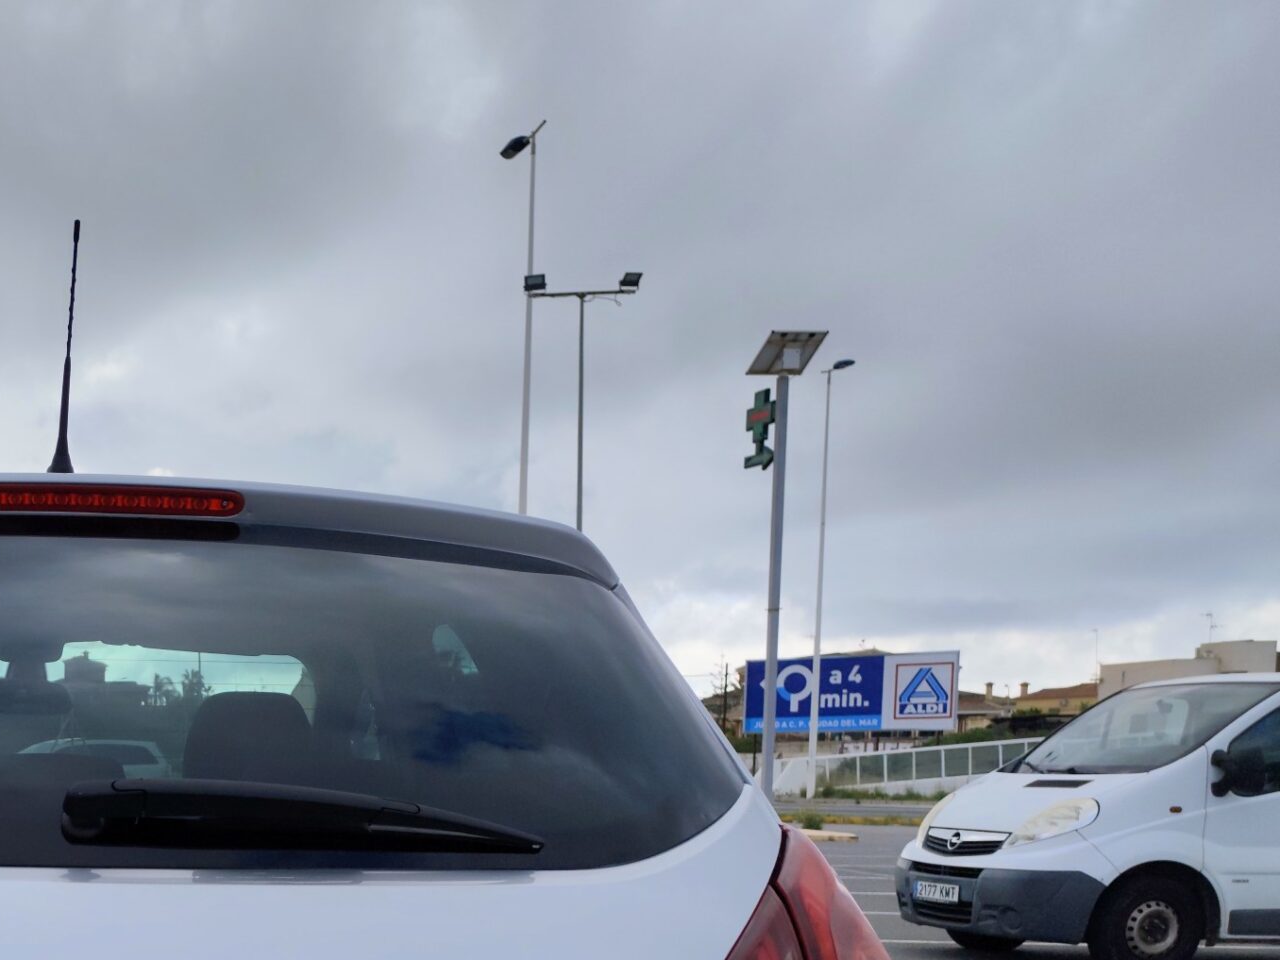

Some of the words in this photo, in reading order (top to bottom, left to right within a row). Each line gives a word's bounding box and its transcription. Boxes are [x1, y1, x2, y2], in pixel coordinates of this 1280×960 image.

[829, 669, 842, 685] a
[848, 665, 862, 684] 4
[820, 688, 869, 708] min.
[903, 703, 944, 714] ALDI
[754, 721, 780, 729] JUO
[840, 719, 856, 728] DEL
[918, 883, 938, 897] 2177
